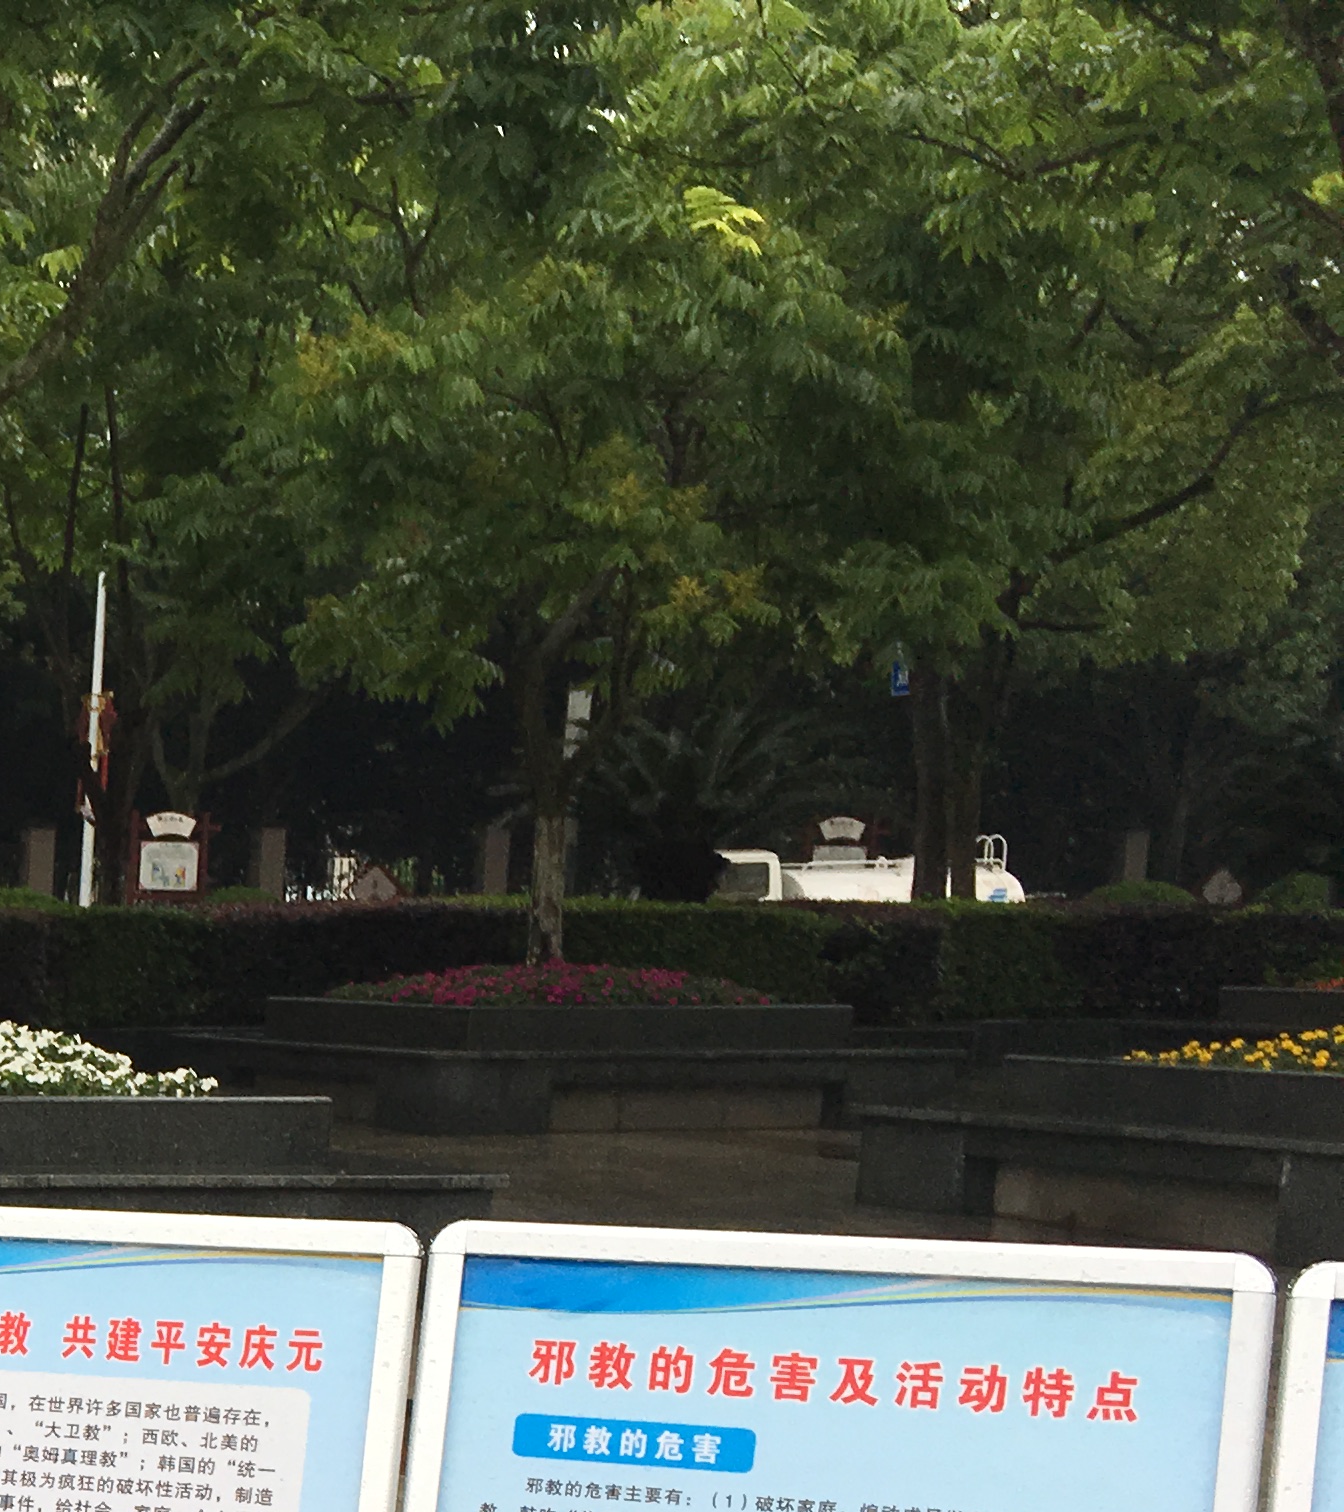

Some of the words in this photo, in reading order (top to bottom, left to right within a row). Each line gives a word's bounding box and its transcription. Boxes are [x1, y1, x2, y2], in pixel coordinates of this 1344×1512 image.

[61, 1313, 325, 1375] 共建平安庆元
[527, 1334, 1141, 1425] 邪教的危害及活动特点
[547, 1422, 721, 1464] 邪教的危害
